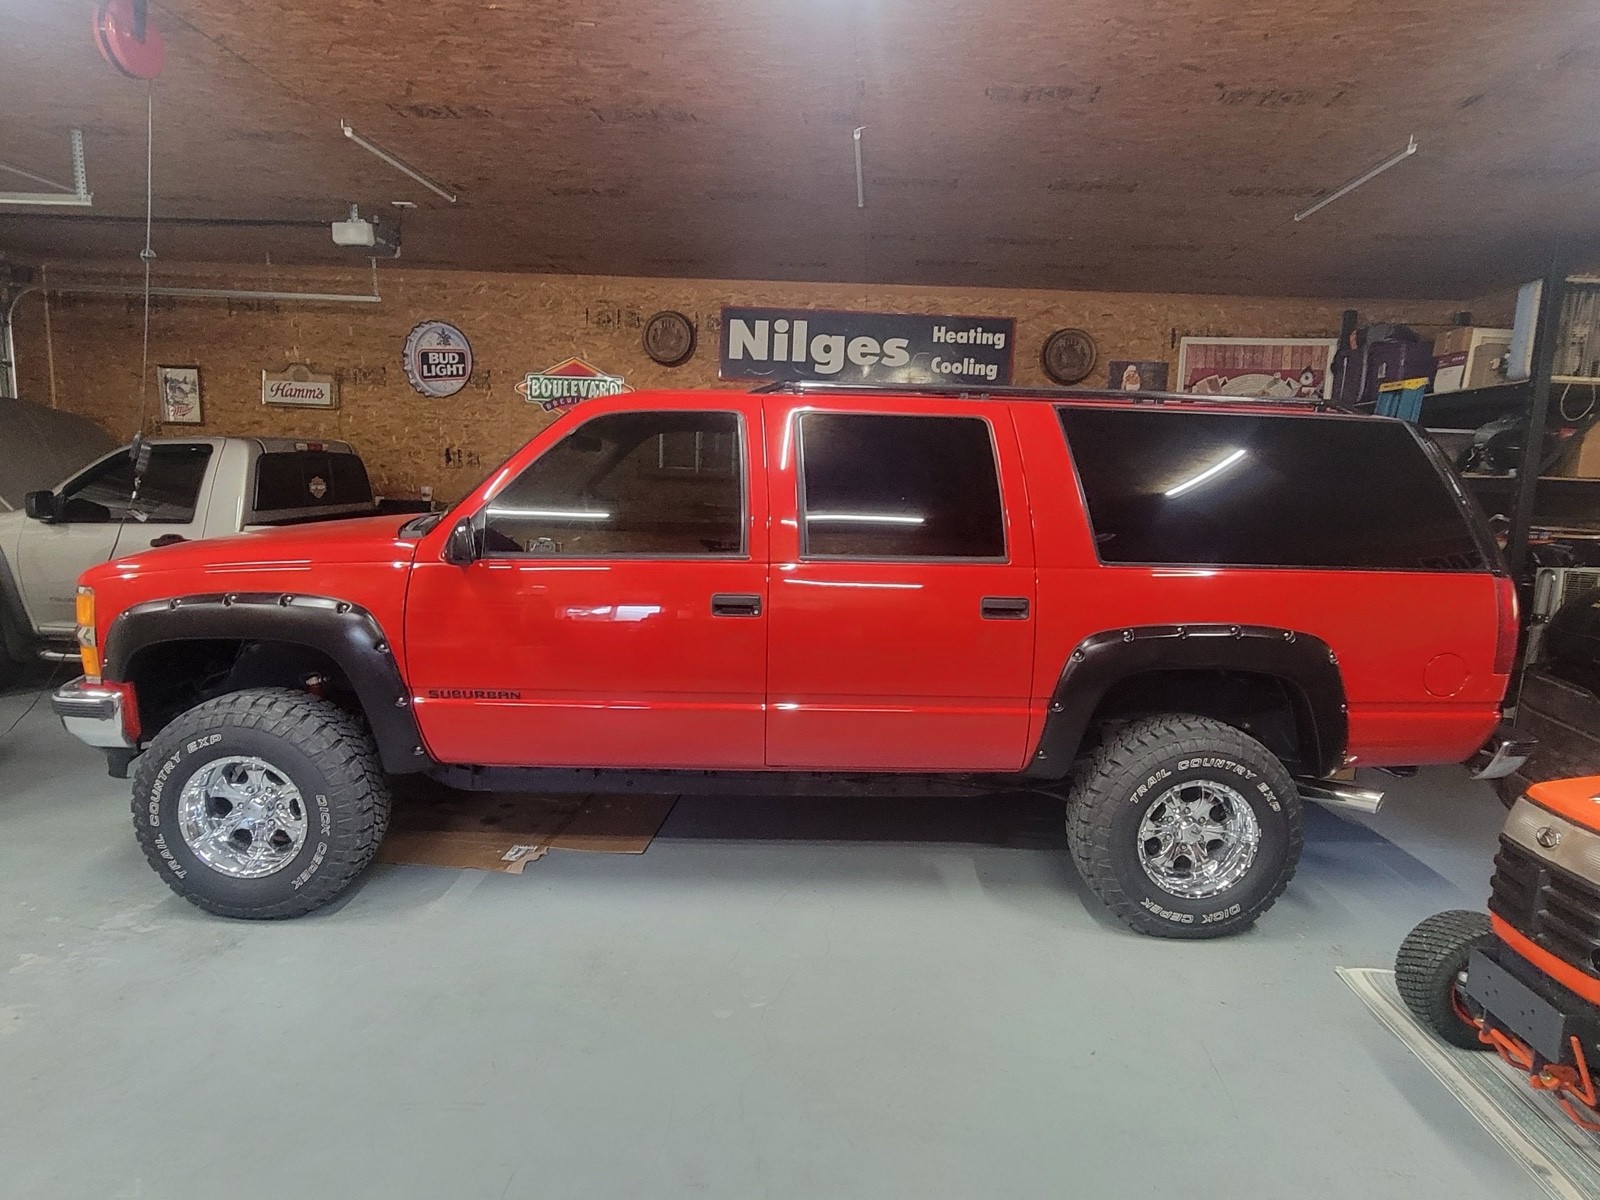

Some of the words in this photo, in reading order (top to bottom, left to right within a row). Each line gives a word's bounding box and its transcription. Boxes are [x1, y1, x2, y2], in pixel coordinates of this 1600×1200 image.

[728, 319, 910, 374] Nilges
[932, 326, 1005, 349] Heating
[428, 352, 459, 364] BUD
[930, 356, 998, 379] Cooling
[422, 364, 465, 376] LIGHT
[270, 382, 325, 400] Hamm's
[531, 378, 619, 398] BOULEVARD
[545, 397, 585, 410] BREWI
[428, 689, 521, 699] SUBURBAN
[186, 733, 222, 754] EXP
[149, 751, 181, 827] COUNTRY
[1130, 768, 1172, 804] TRAIL
[1177, 757, 1257, 781] COUNTRY
[1256, 782, 1281, 812] EXP
[315, 794, 331, 836] DICK
[155, 833, 188, 879] TRAIL
[291, 842, 328, 890] CEPEK
[1140, 897, 1195, 924] CEPEK
[1201, 903, 1241, 924] DICK
